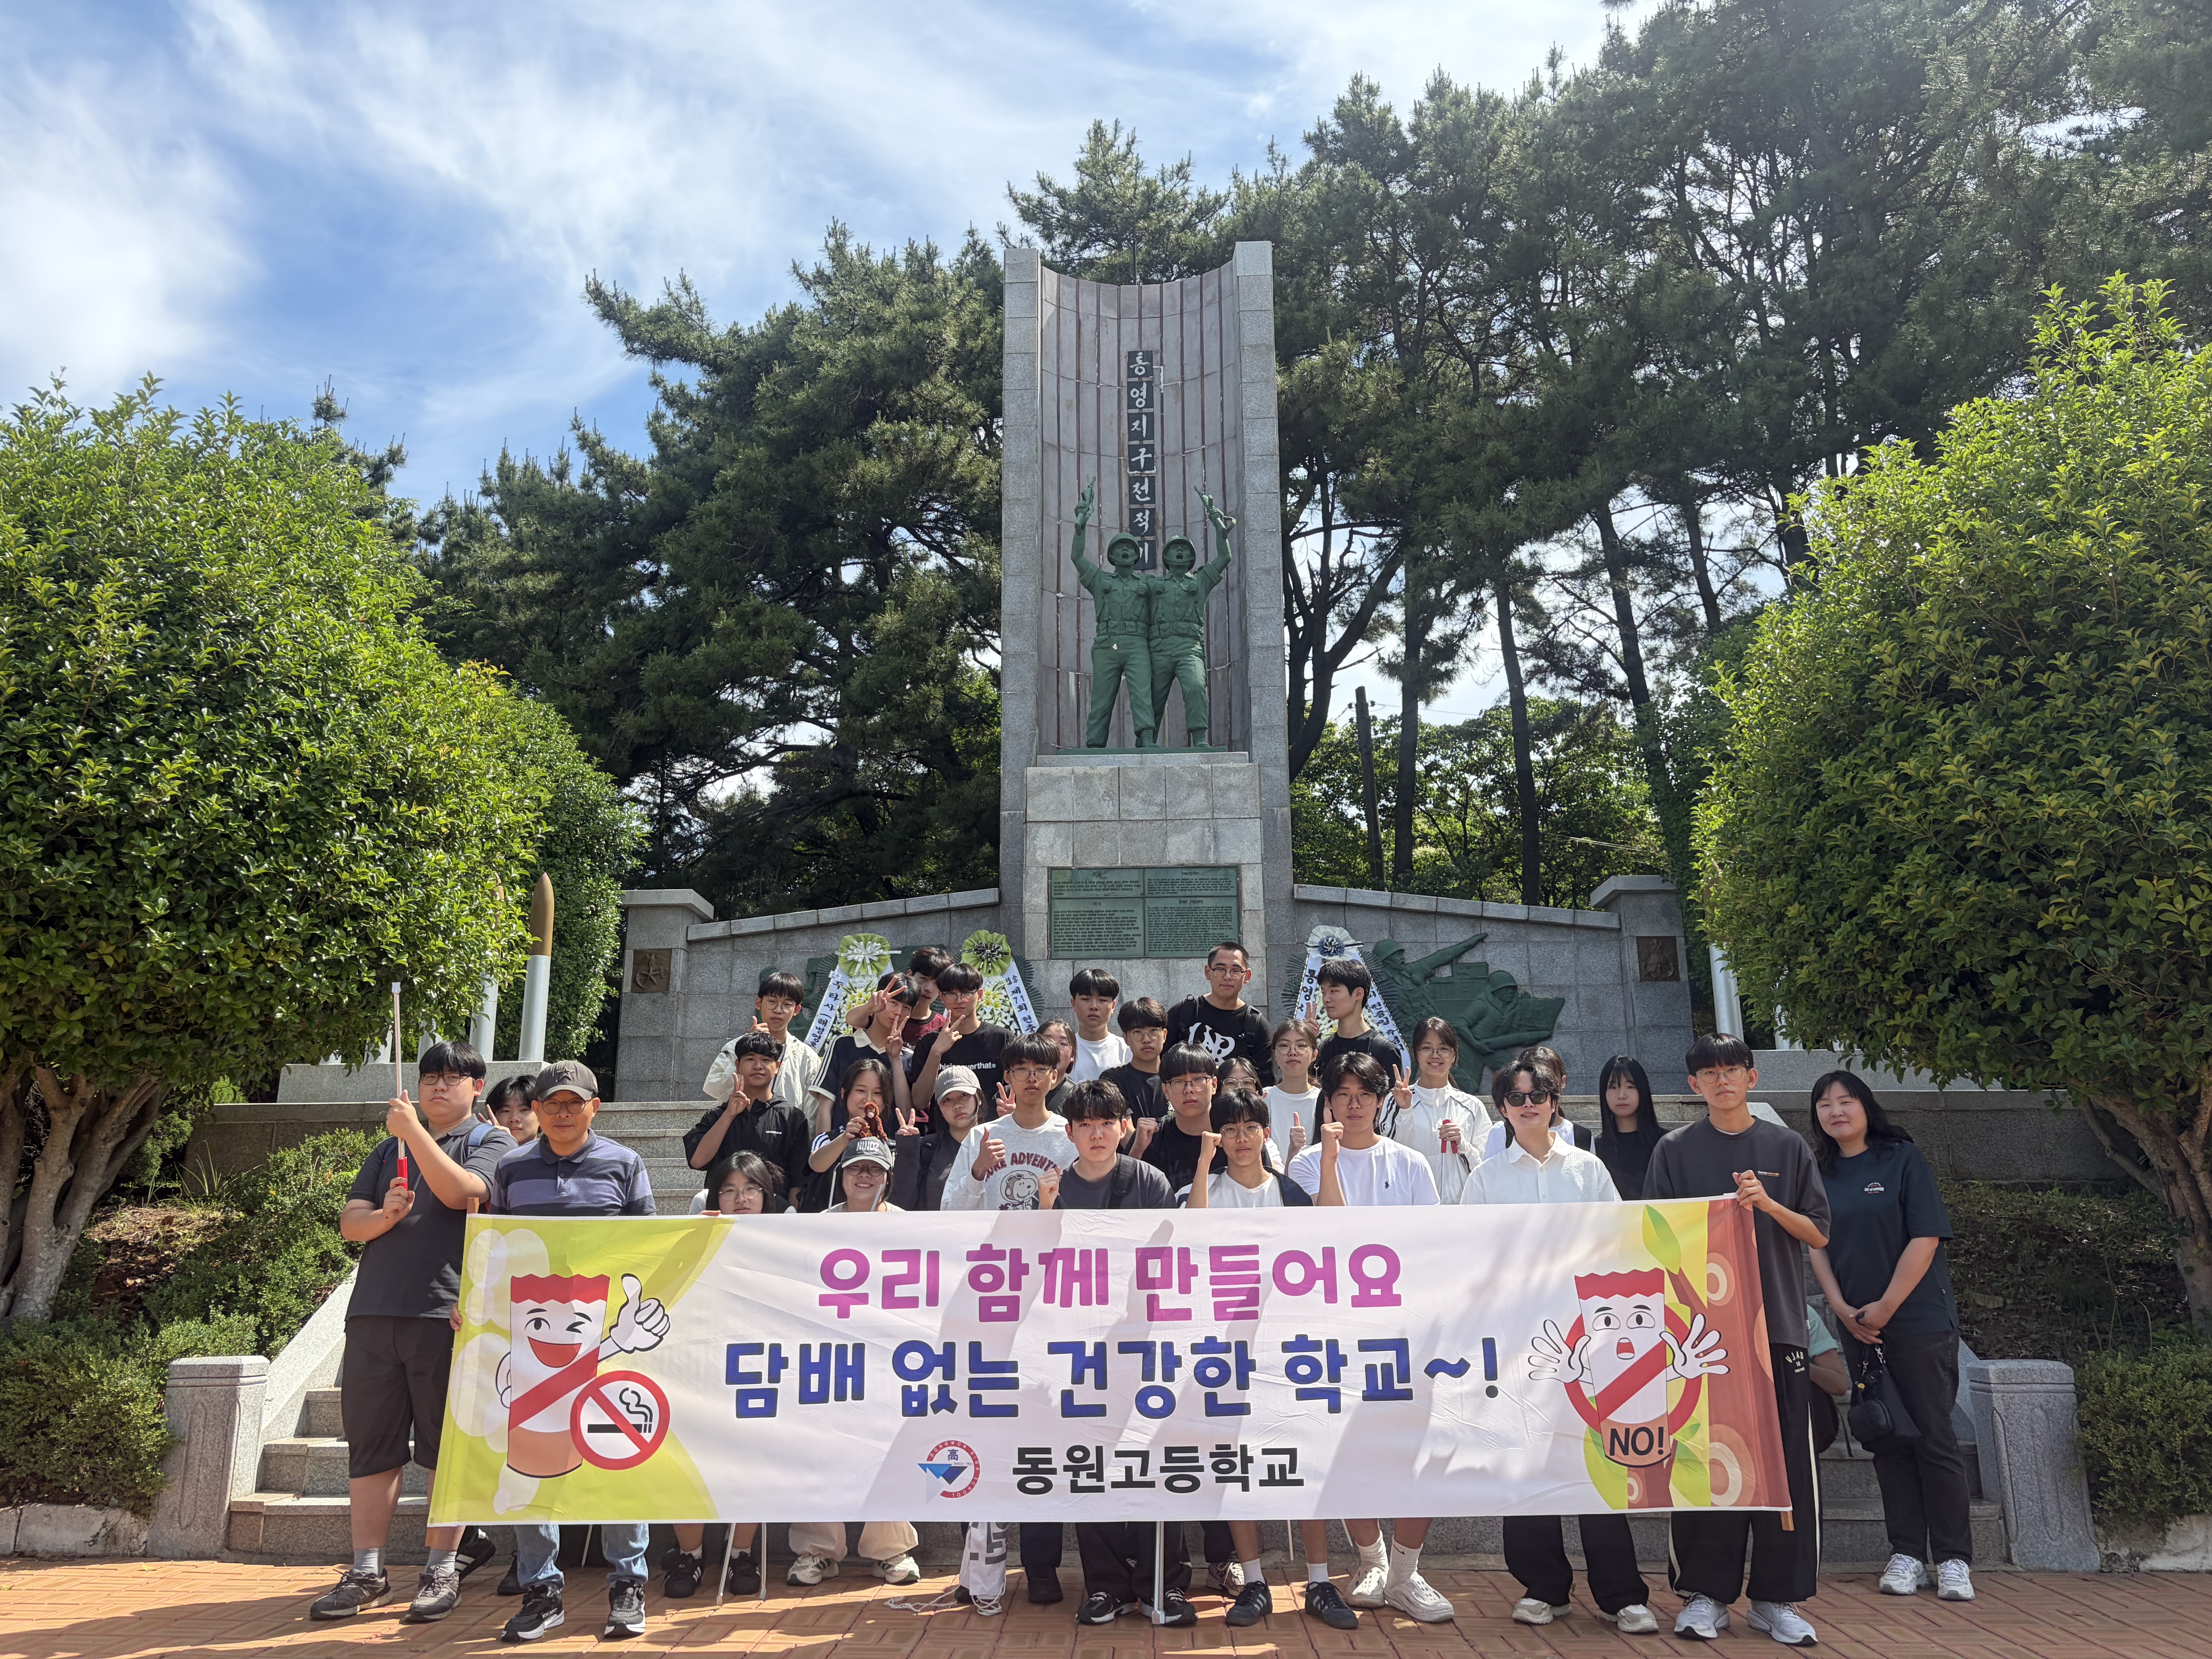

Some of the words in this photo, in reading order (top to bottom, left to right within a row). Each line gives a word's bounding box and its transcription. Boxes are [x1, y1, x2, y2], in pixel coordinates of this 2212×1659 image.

[818, 1248, 940, 1319] 우리
[966, 1243, 1109, 1323] 함께
[1135, 1244, 1402, 1322] 만들어요
[725, 1342, 866, 1419] 담배
[891, 1340, 1020, 1418] 없는
[1047, 1336, 1257, 1419] 건강한
[1281, 1334, 1498, 1414] 학교~!
[930, 1441, 967, 1457] DONGWON
[1609, 1426, 1664, 1456] NO!
[948, 1448, 959, 1461] 高
[970, 1451, 980, 1471] HIGH
[1012, 1444, 1304, 1496] 동원고등학교
[952, 1477, 978, 1498] SCHOOL
